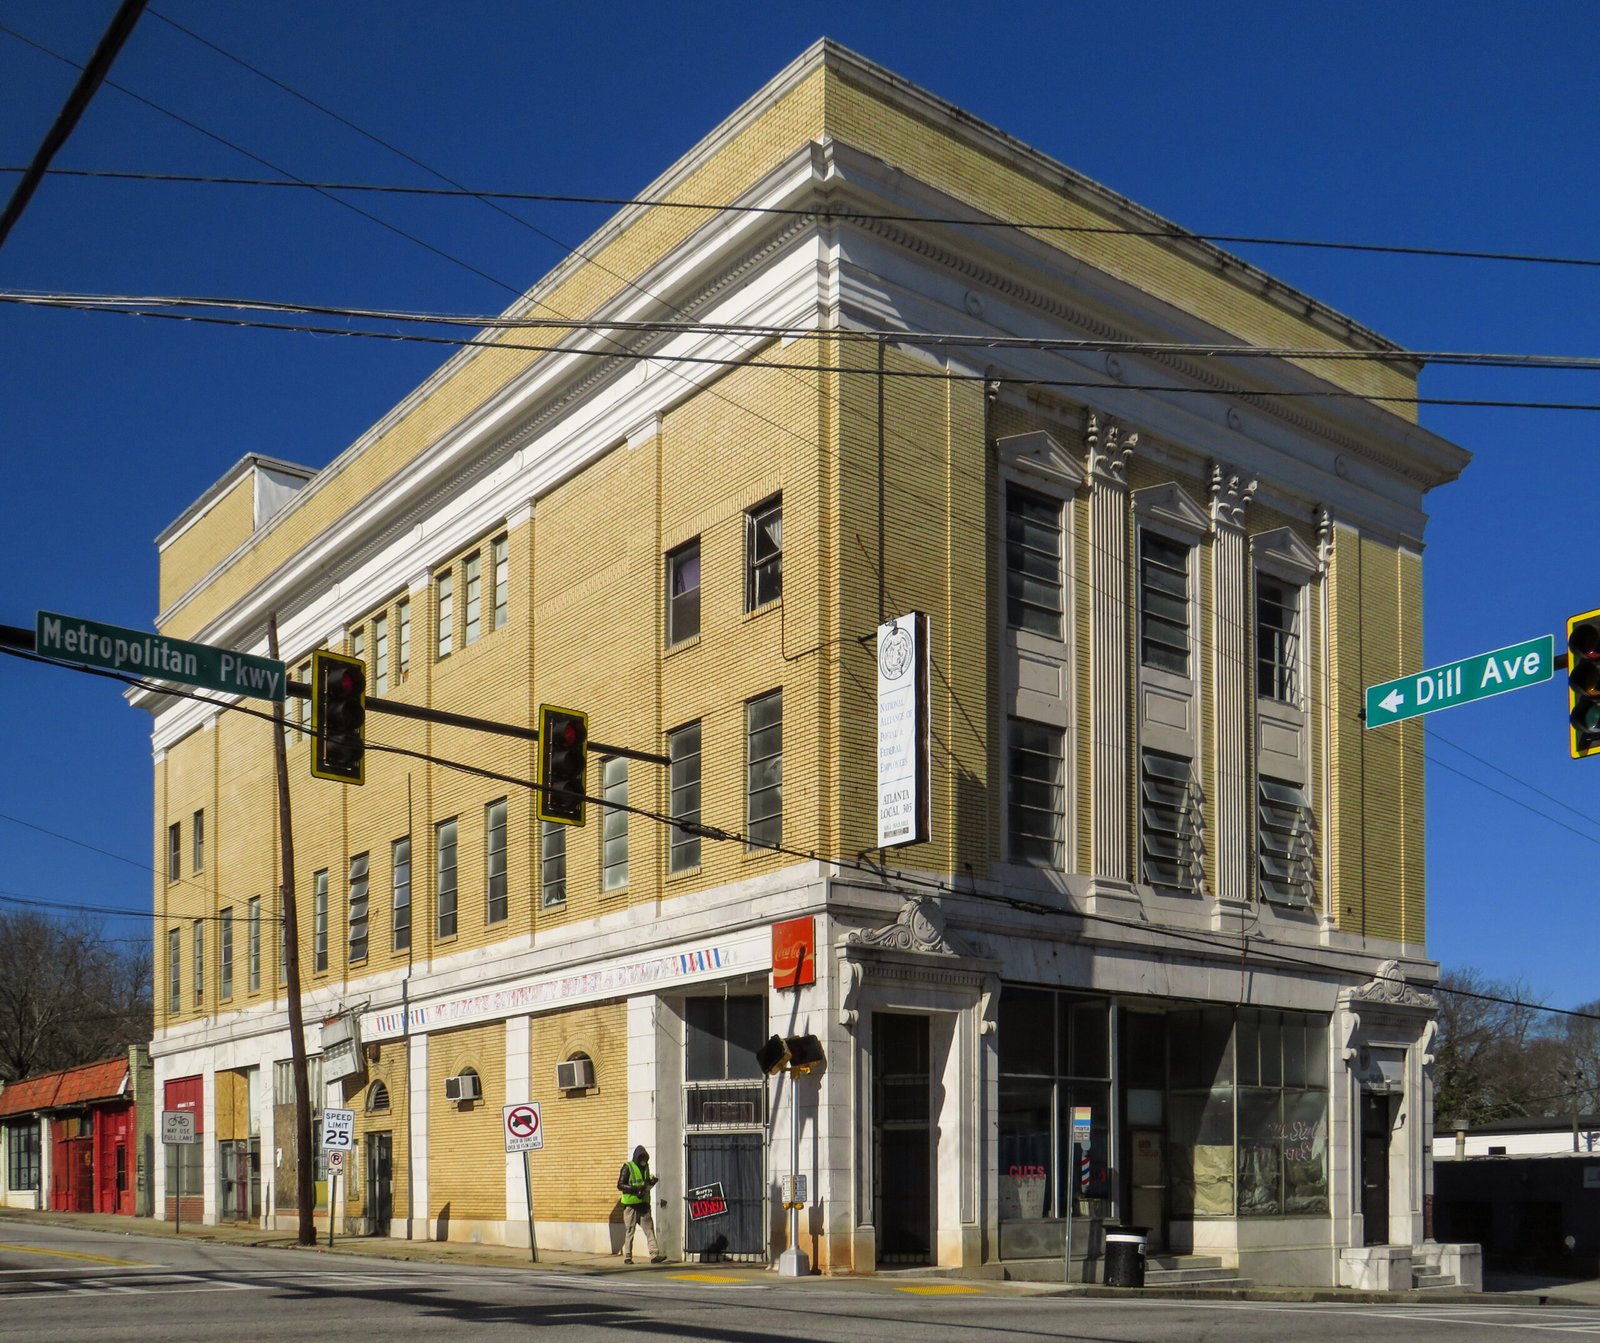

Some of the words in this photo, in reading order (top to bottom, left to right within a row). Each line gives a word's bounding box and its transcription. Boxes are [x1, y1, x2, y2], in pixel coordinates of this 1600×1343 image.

[43, 616, 197, 676] Metropolitan
[220, 655, 280, 698] Pkwy
[1416, 666, 1461, 706] Dill
[1480, 652, 1540, 688] Ave
[883, 789, 910, 805] ATLANTA
[880, 805, 900, 819] LOCAL
[774, 940, 808, 962] Coca-Coa
[326, 1113, 352, 1121] SPEED
[328, 1121, 349, 1129] LIMIT
[325, 1129, 349, 1145] 25
[1009, 1165, 1046, 1181] CUTS
[691, 1197, 724, 1217] CLOSED
